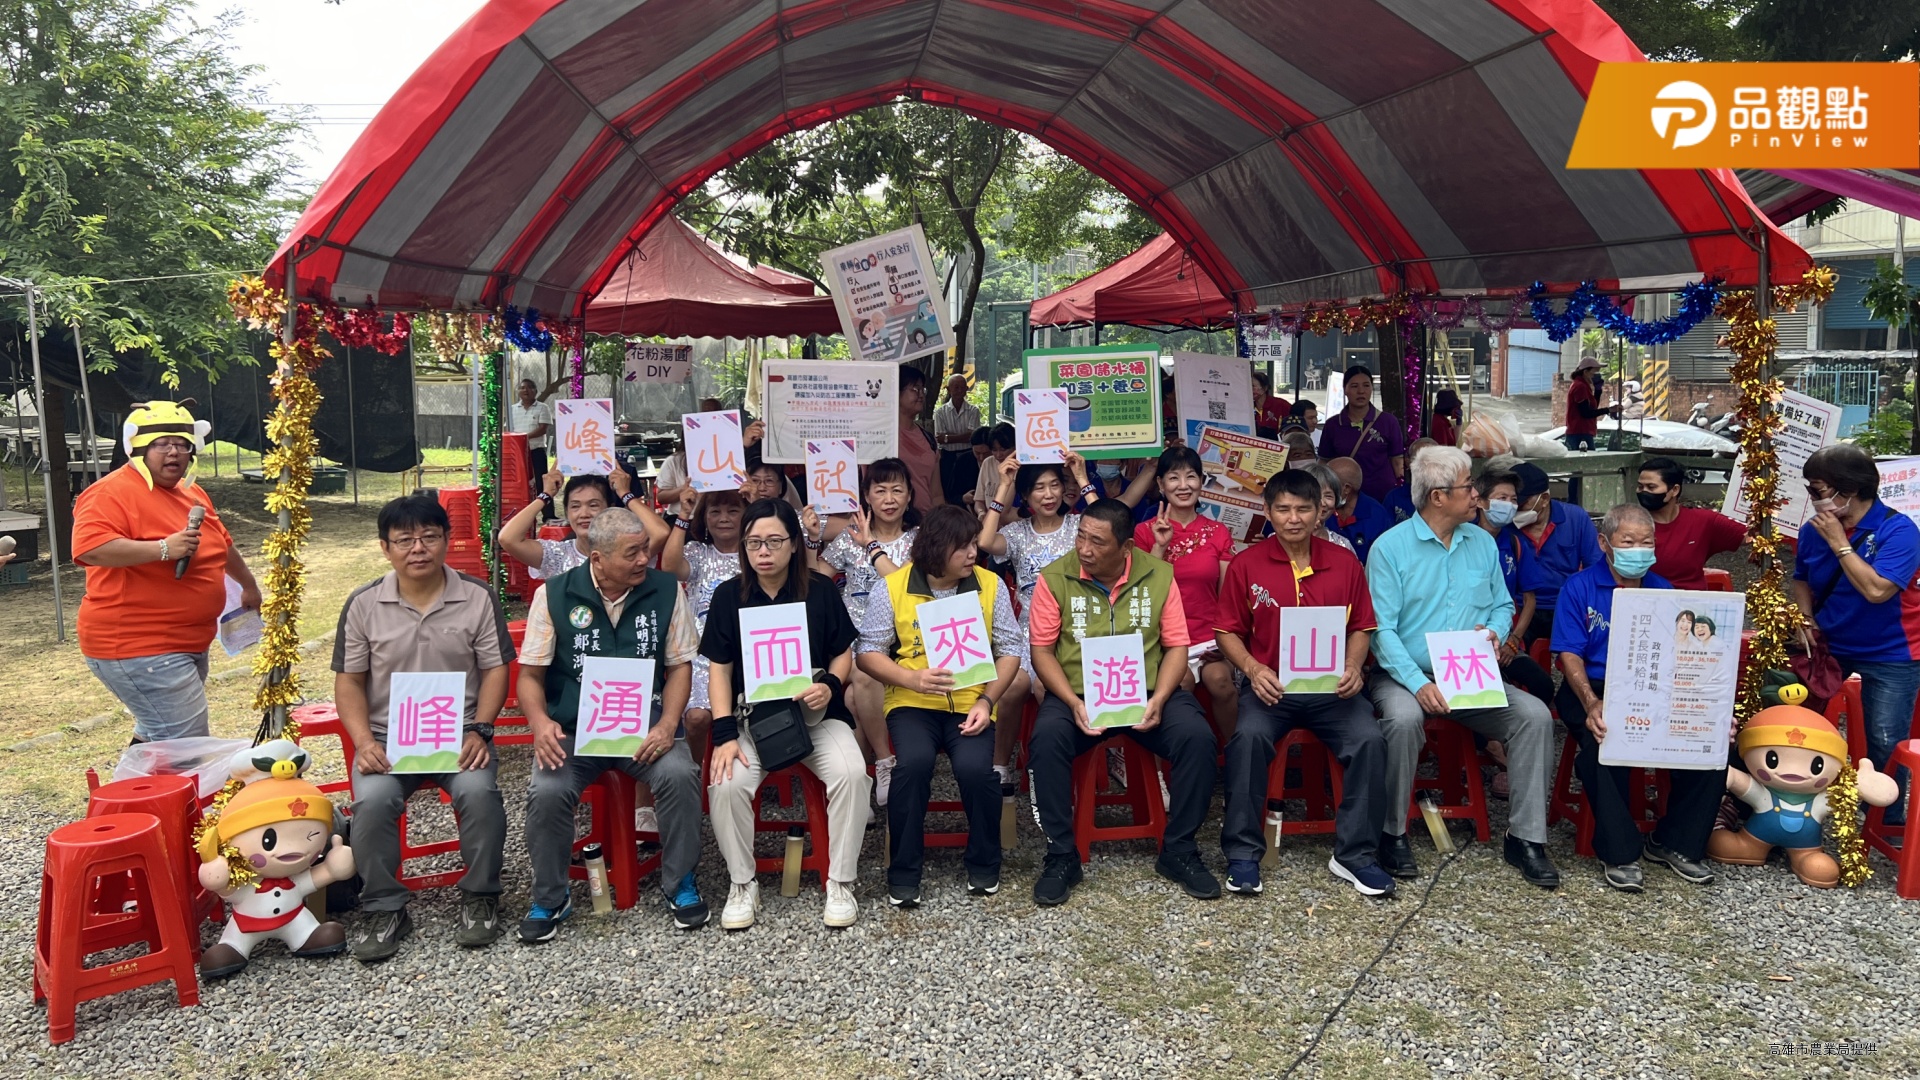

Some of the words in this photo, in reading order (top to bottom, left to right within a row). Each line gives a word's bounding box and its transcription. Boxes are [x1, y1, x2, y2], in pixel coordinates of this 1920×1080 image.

[847, 276, 860, 286] 行人
[631, 348, 688, 362] 花粉湯圓
[647, 366, 672, 377] DIY
[565, 418, 607, 459] 峰
[1026, 409, 1061, 448] 區
[698, 434, 733, 473] 山
[814, 460, 847, 497] 社
[1878, 483, 1905, 499] 革熱
[591, 629, 601, 652] 里長
[635, 614, 650, 657] 陳明澤
[651, 610, 659, 652] 高雄市議員
[750, 626, 803, 678] 而
[931, 617, 986, 669] 來
[1290, 628, 1336, 672] 山
[1440, 648, 1495, 690] 林
[1634, 614, 1652, 691] 四大長照給付
[1648, 642, 1661, 691] 政府有補助
[1093, 655, 1141, 707] 遊
[398, 696, 457, 749] 峰
[586, 680, 642, 734] 湧
[1625, 716, 1650, 726] 1966
